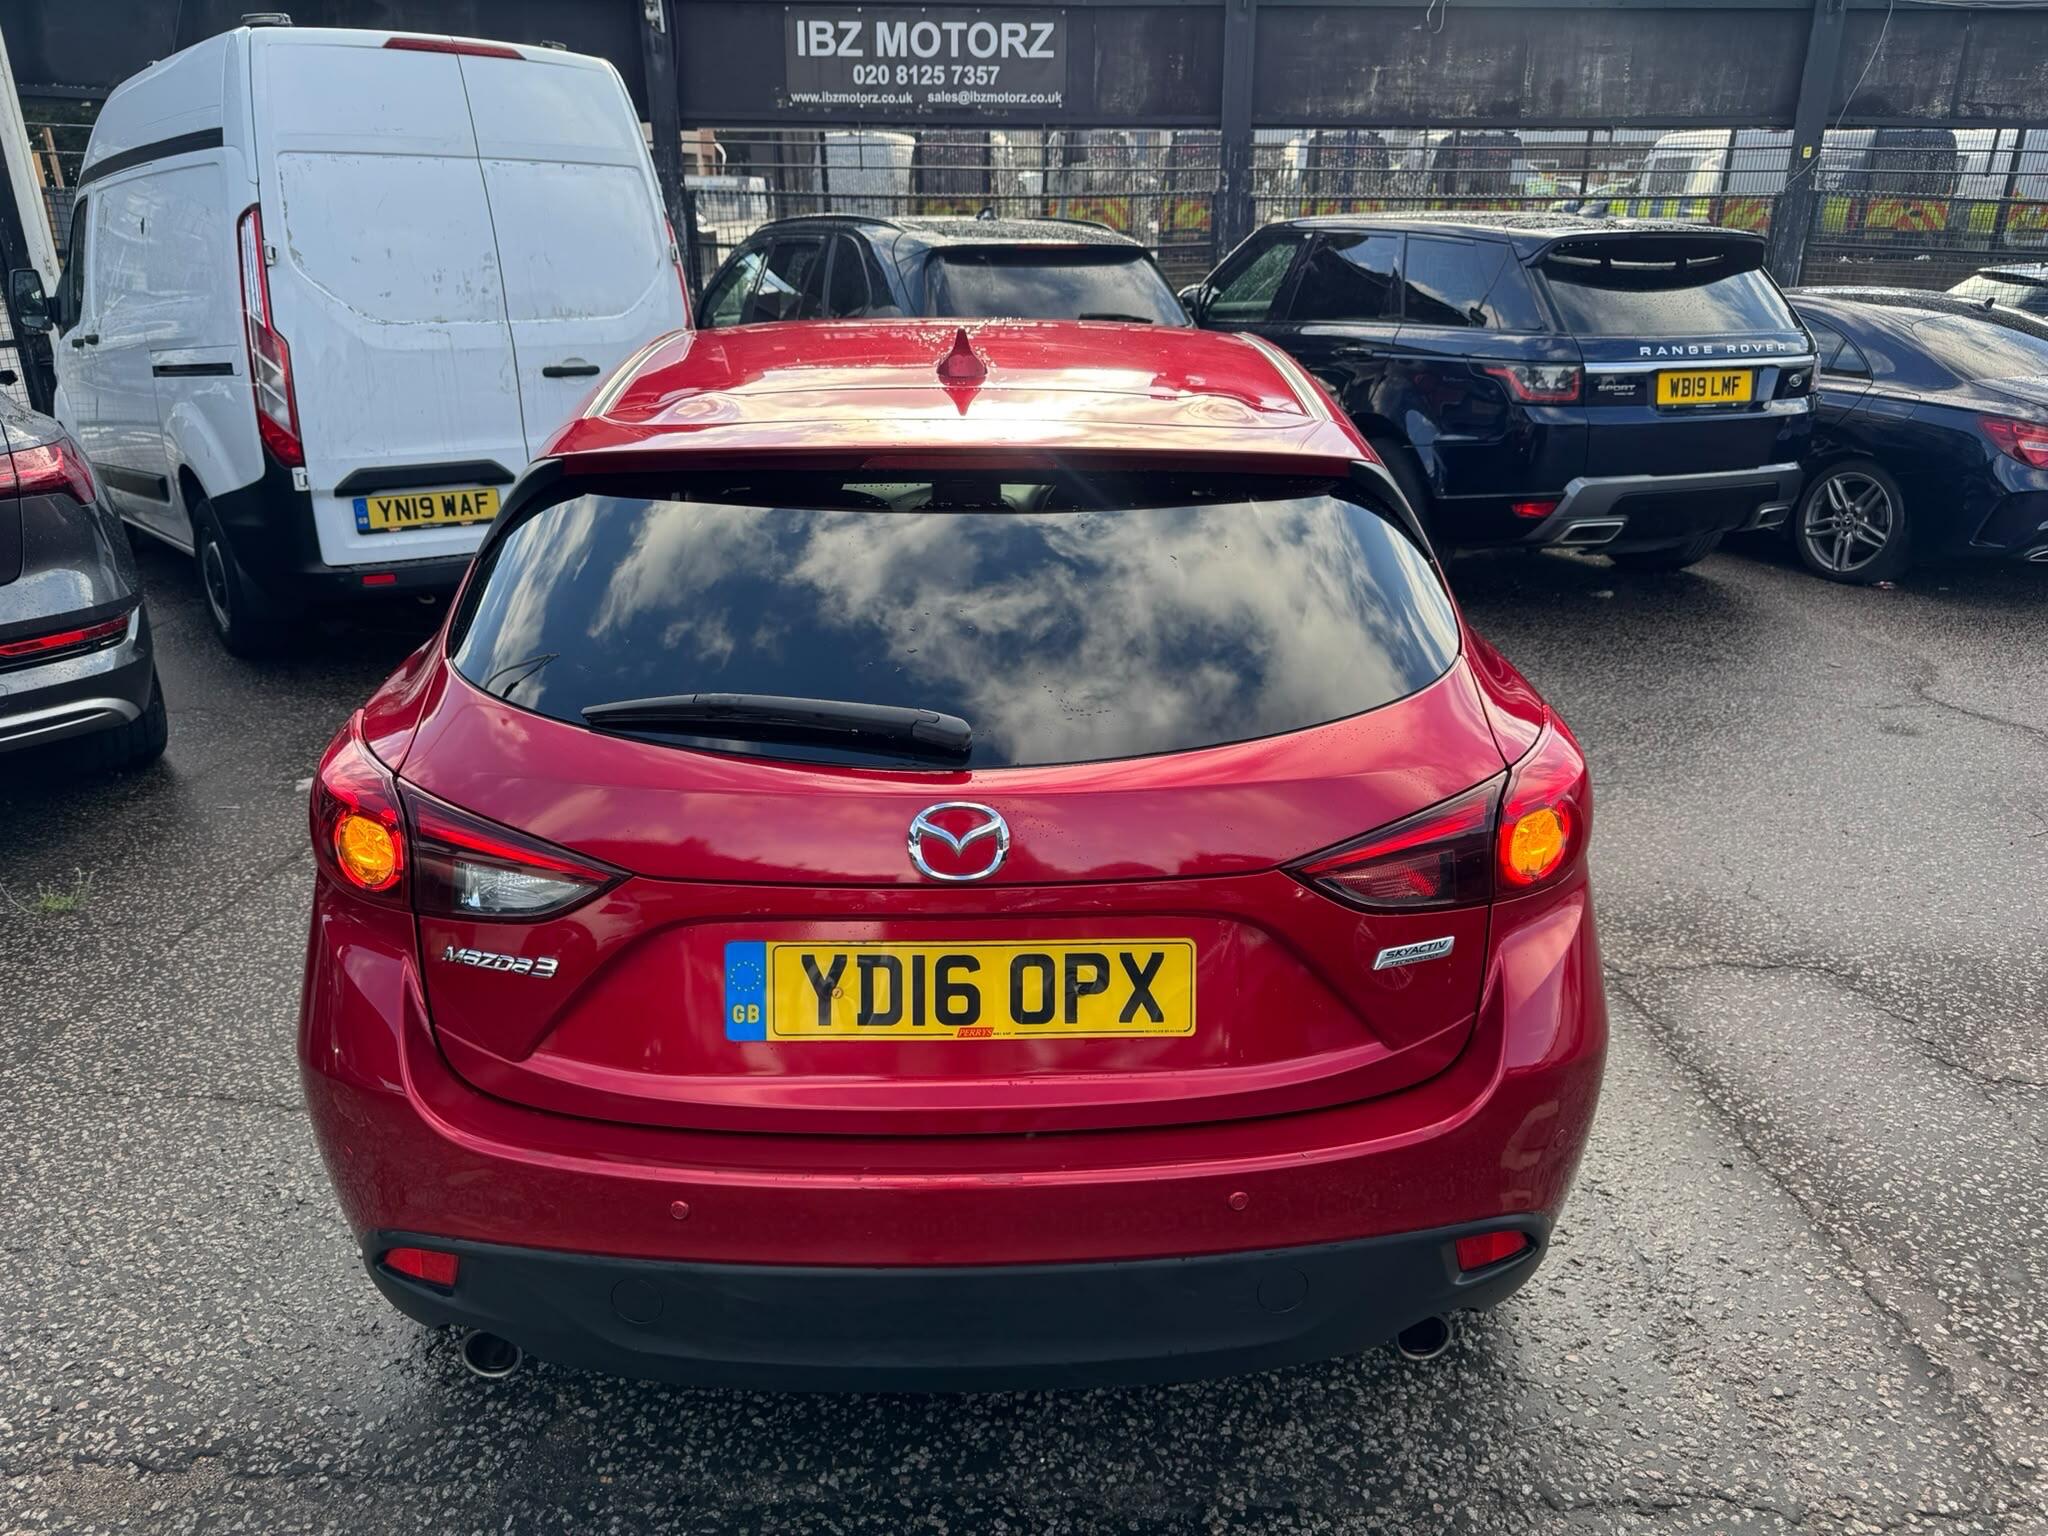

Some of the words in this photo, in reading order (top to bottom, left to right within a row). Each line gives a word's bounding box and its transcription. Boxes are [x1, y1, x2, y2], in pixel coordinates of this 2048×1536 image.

[796, 20, 864, 57] IBZ
[875, 21, 1055, 58] MOTORZ
[853, 65, 890, 86] 020
[896, 65, 945, 86] 8125
[951, 65, 1000, 86] 7357
[790, 91, 913, 104] www.ibzmotorz.co.uk
[927, 90, 1062, 105] sales@ibzmotorz.co.uk
[1639, 345, 1713, 356] RANGE
[1726, 343, 1786, 354] ROVER
[1597, 384, 1637, 392] SPORT
[1669, 376, 1706, 398] WB19
[1711, 376, 1742, 395] LMF
[376, 496, 435, 522] YN19
[441, 492, 489, 517] WAF
[1385, 940, 1449, 960] SKYACTIV
[800, 953, 982, 1027] YD16
[1009, 951, 1165, 1025] OPX
[731, 1003, 760, 1024] GB
[958, 1027, 993, 1038] PERRYS
